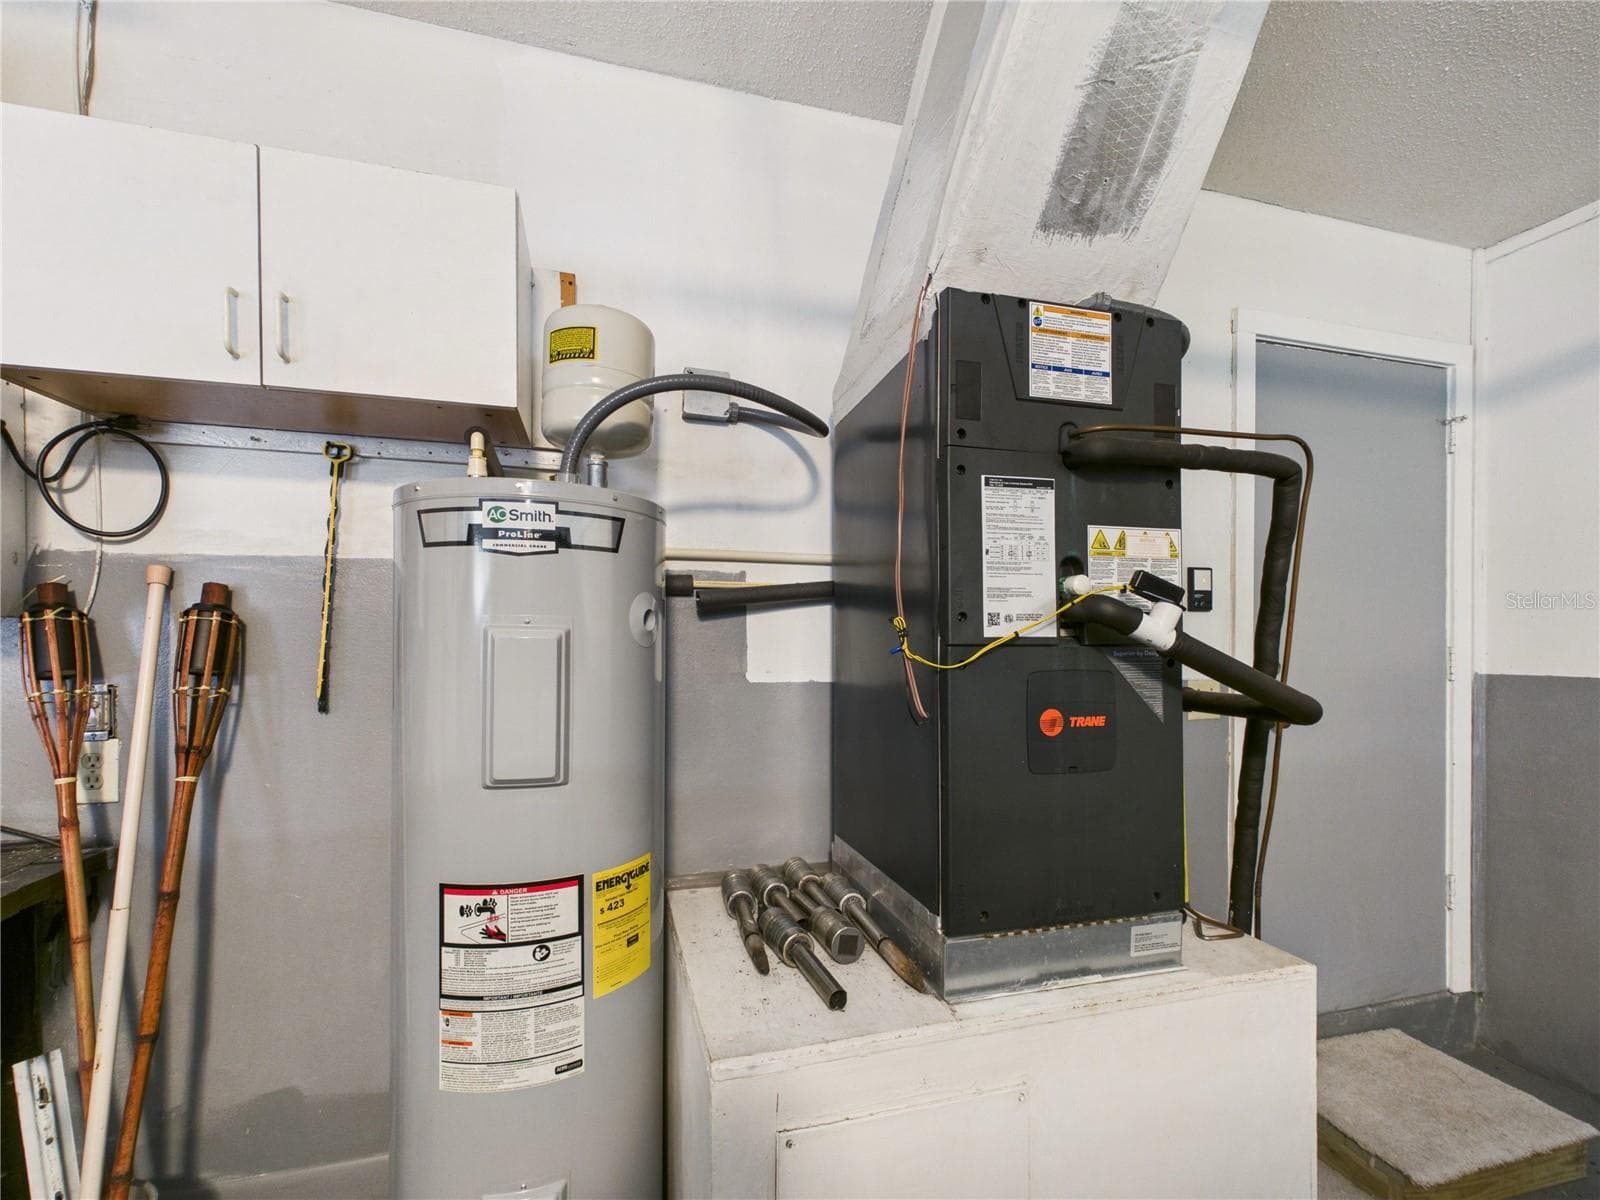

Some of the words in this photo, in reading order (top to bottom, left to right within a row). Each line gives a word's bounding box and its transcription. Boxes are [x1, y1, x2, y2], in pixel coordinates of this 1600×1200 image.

[497, 530, 541, 539] ProLine
[1069, 715, 1106, 728] TRANE
[595, 860, 650, 892] ENERGYGUIDE
[500, 887, 528, 895] DANGER
[607, 898, 625, 912] 423
